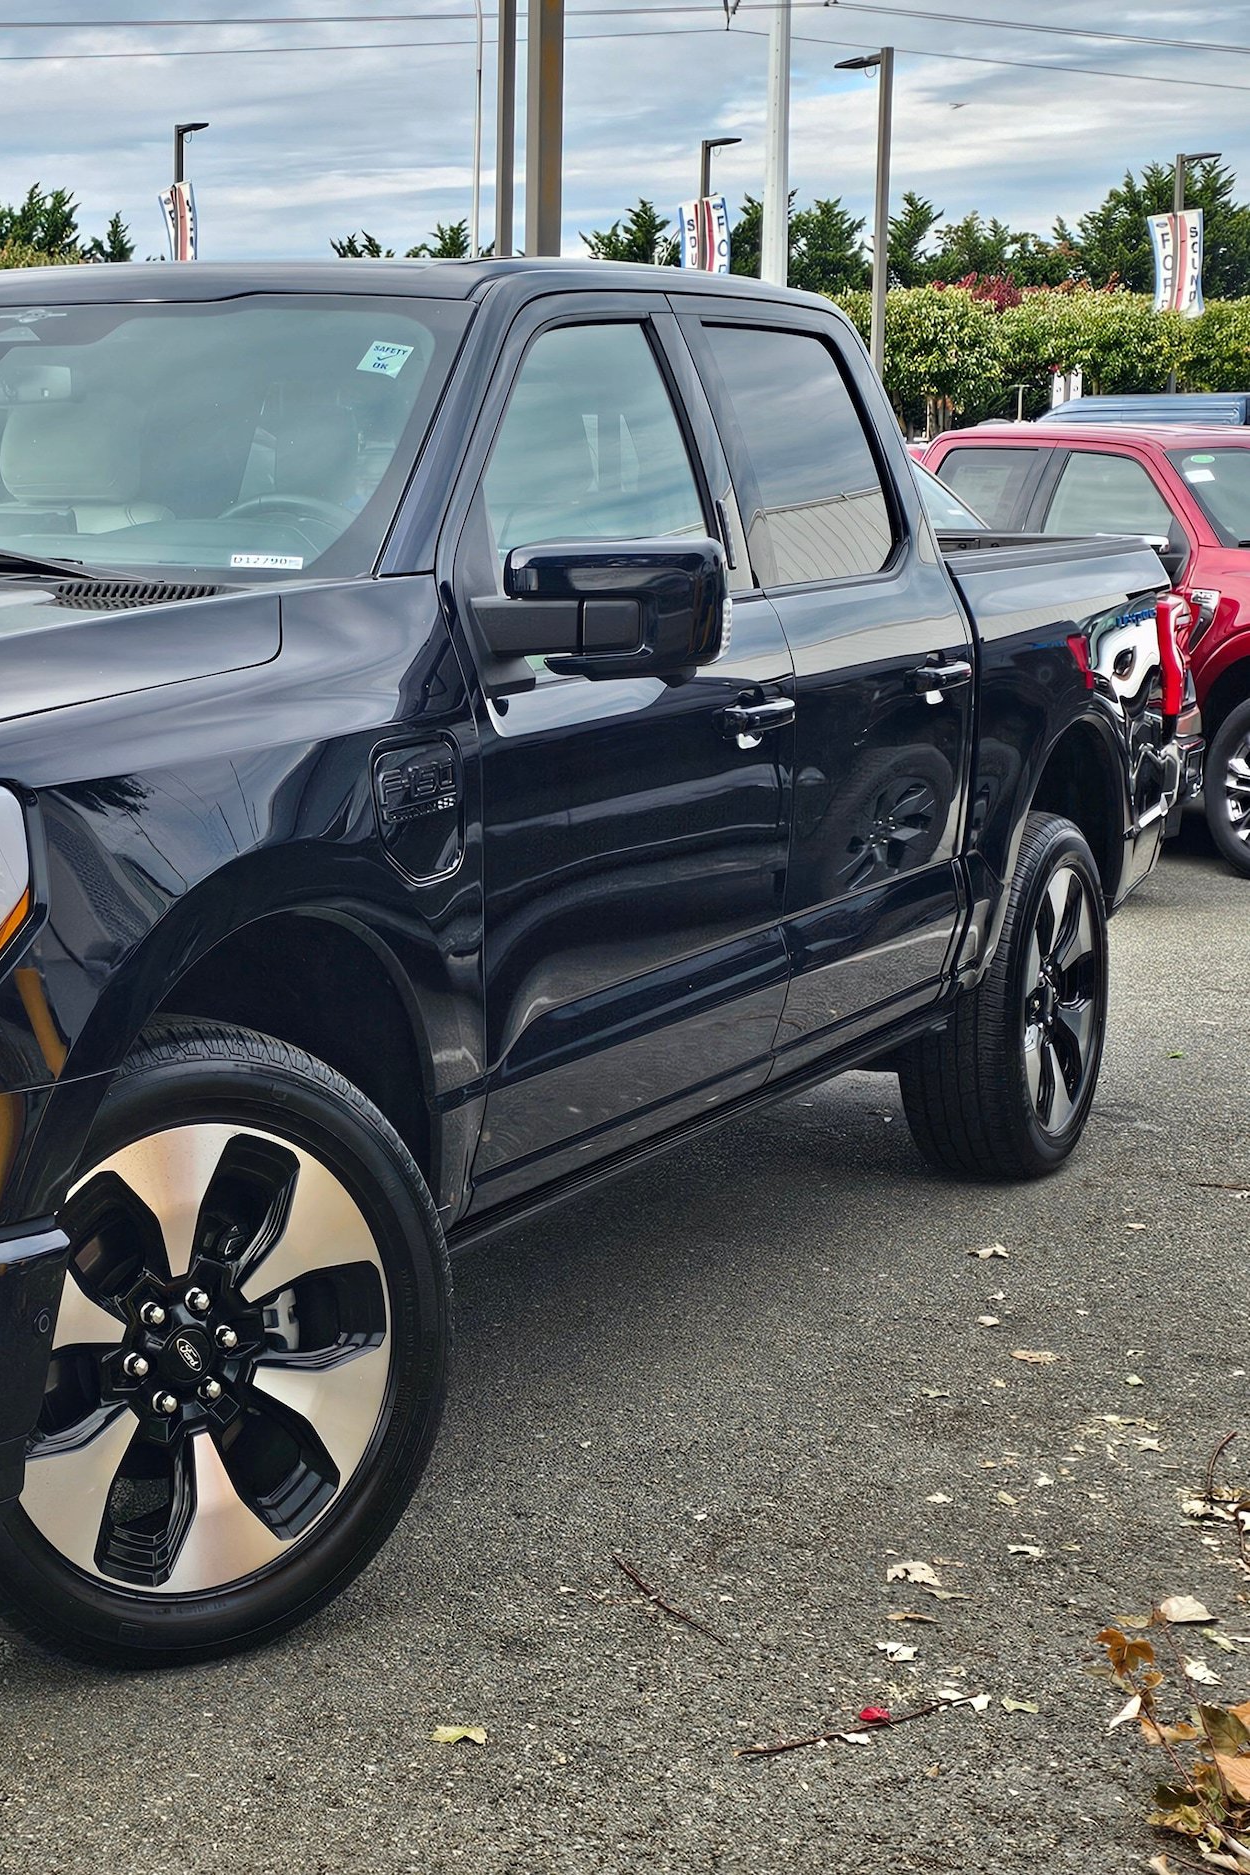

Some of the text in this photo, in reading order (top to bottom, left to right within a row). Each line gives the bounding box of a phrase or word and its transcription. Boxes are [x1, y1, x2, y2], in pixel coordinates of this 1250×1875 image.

[373, 345, 409, 356] SAFETY
[372, 362, 389, 370] OK
[180, 1344, 199, 1367] Ford
